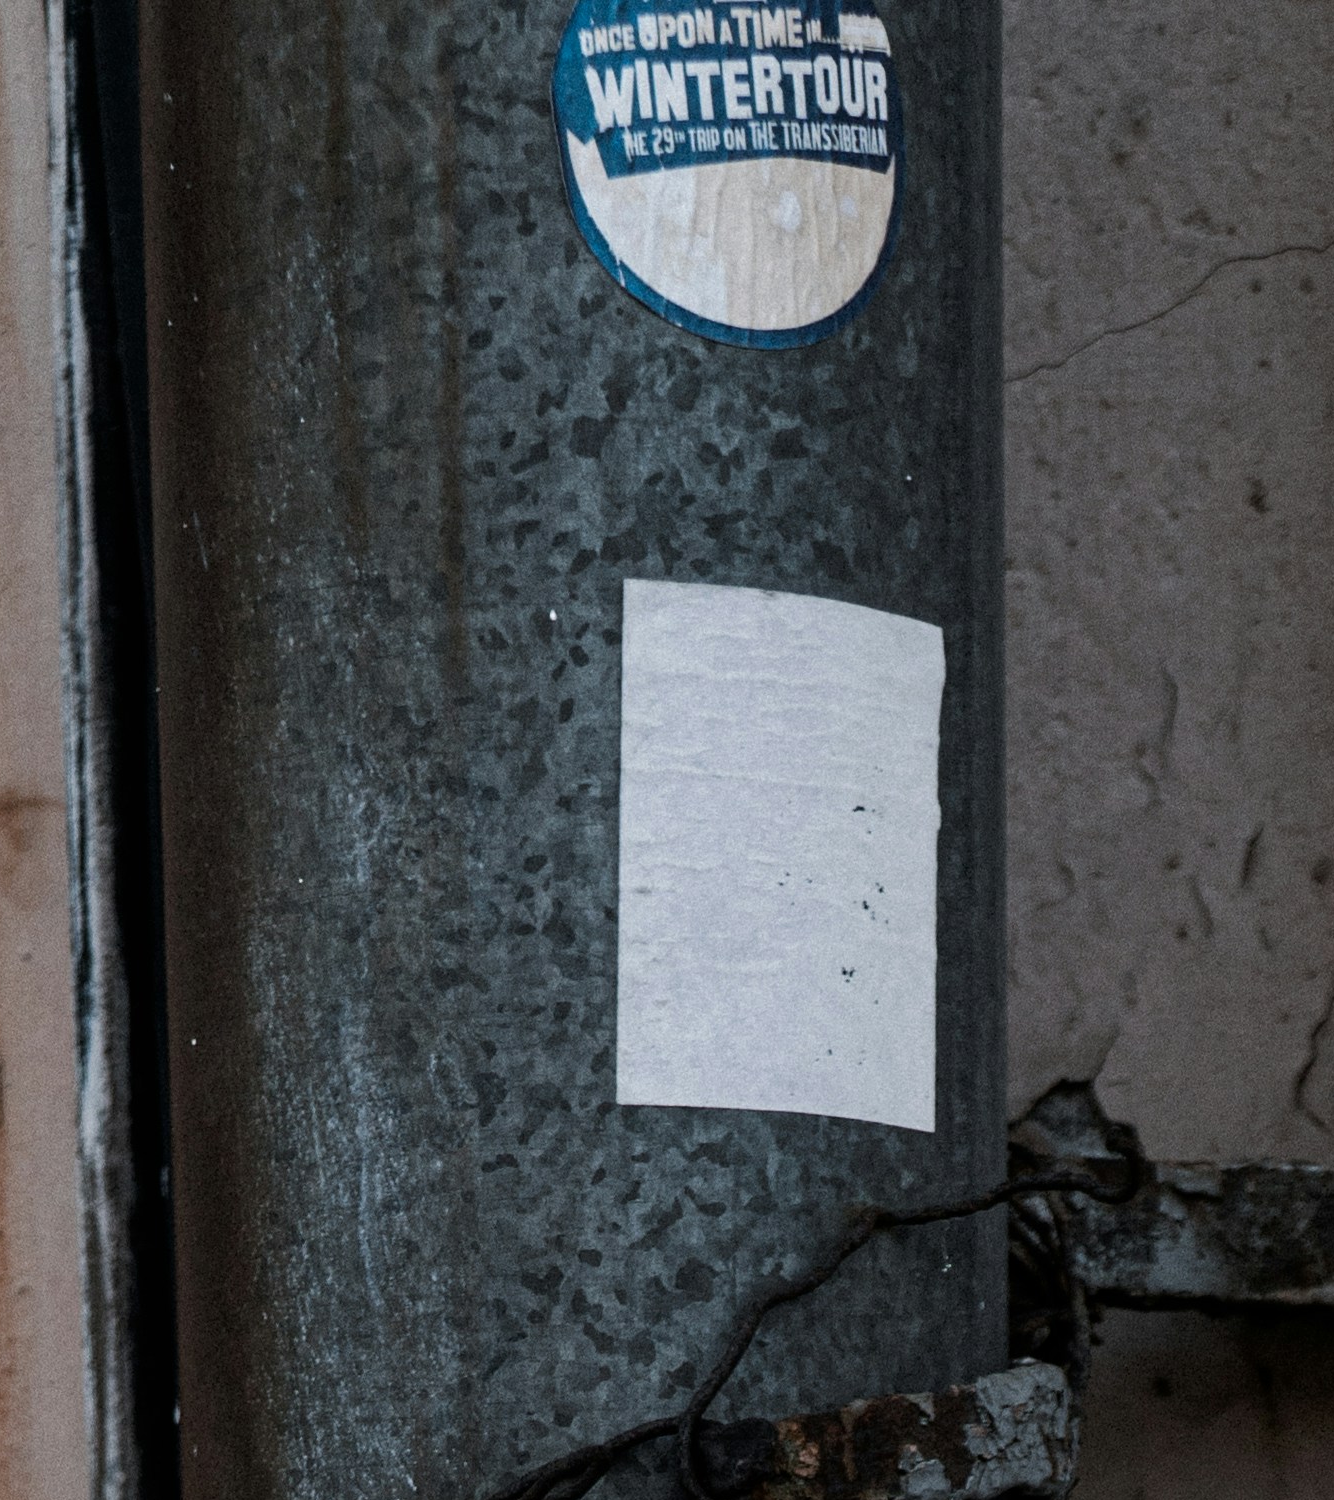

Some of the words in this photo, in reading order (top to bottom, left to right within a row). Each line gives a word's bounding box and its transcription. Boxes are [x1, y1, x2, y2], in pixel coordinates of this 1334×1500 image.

[578, 23, 636, 57] ONCE
[637, 8, 717, 51] UPON
[720, 19, 733, 45] A
[730, 7, 805, 50] TIME
[584, 54, 889, 133] WINTERTOUR
[688, 127, 720, 153] TRIP
[723, 127, 747, 151] ON
[748, 121, 778, 151] THE
[781, 120, 889, 157] TRANSSIBERIAN
